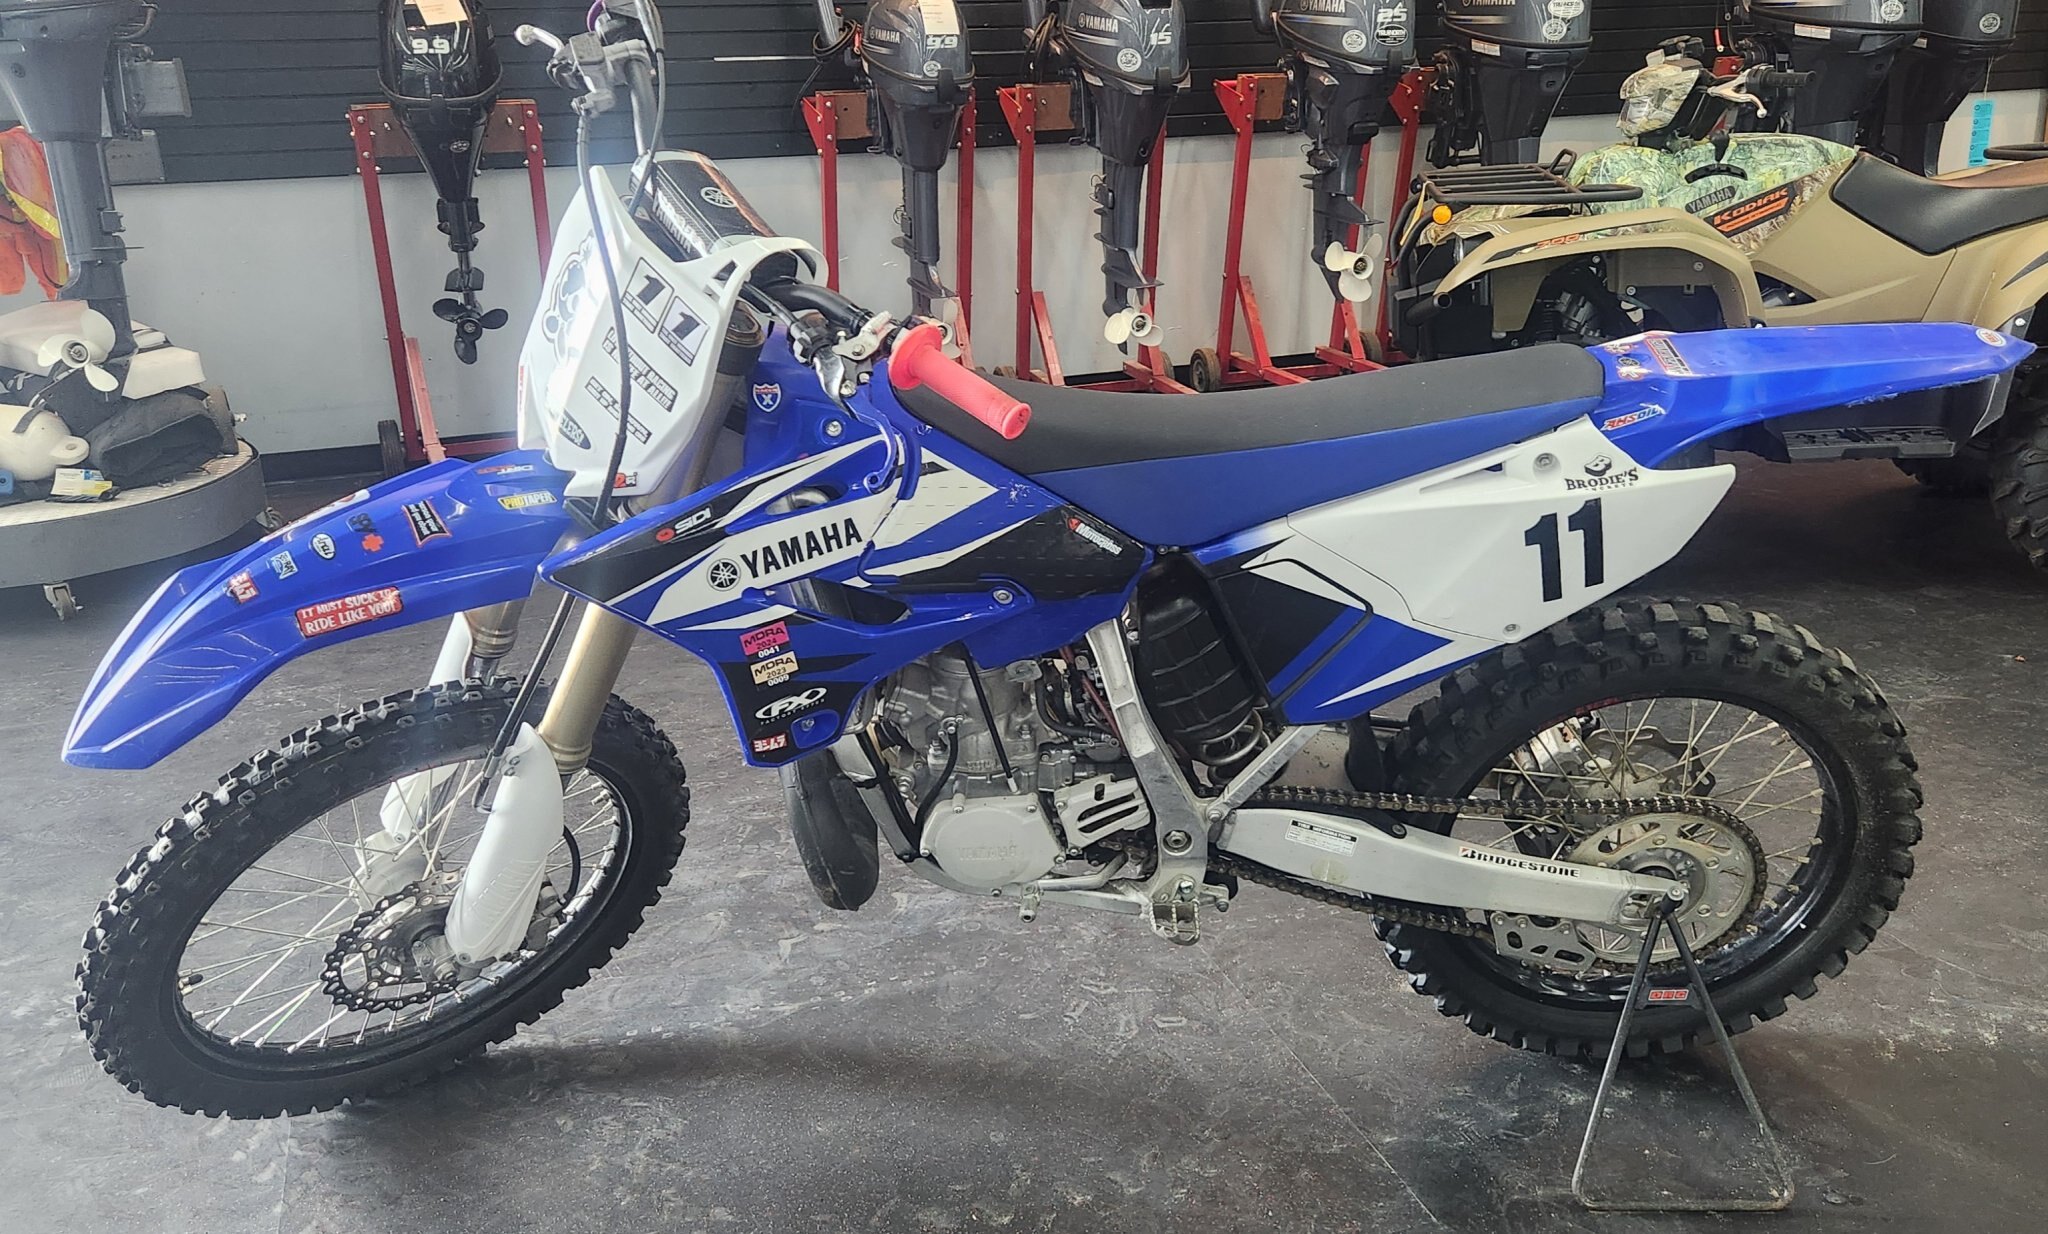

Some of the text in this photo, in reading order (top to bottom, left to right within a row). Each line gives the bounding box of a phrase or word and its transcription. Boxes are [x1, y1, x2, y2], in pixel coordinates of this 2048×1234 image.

[1308, 0, 1345, 12] YAMAHA
[1377, 8, 1407, 22] 25
[1086, 16, 1118, 32] YAMAHA
[875, 29, 900, 44] YAMAHA
[927, 36, 958, 48] 9.9
[1150, 32, 1172, 45] 15
[412, 38, 450, 54] 9.9
[1688, 187, 1733, 212] YAMAHA
[1713, 187, 1789, 225] KODIAK
[1536, 234, 1580, 250] 700
[762, 394, 773, 405] X
[1606, 406, 1660, 428] AMSOIL
[1564, 466, 1638, 490] BRODIE'S
[503, 492, 553, 508] PROTAPER
[674, 508, 712, 534] SIDI
[740, 518, 862, 578] YAMAHA
[1524, 498, 1604, 602] 11
[302, 608, 314, 618] IT
[317, 602, 342, 614] MUST
[344, 592, 378, 608] SUCK
[305, 616, 336, 634] RIDE
[338, 607, 366, 624] LIKE
[757, 638, 777, 650] 2024
[758, 645, 780, 658] 0041
[766, 666, 786, 678] 2023
[768, 674, 790, 686] 0009
[1461, 848, 1579, 878] BRIDGESTONE
